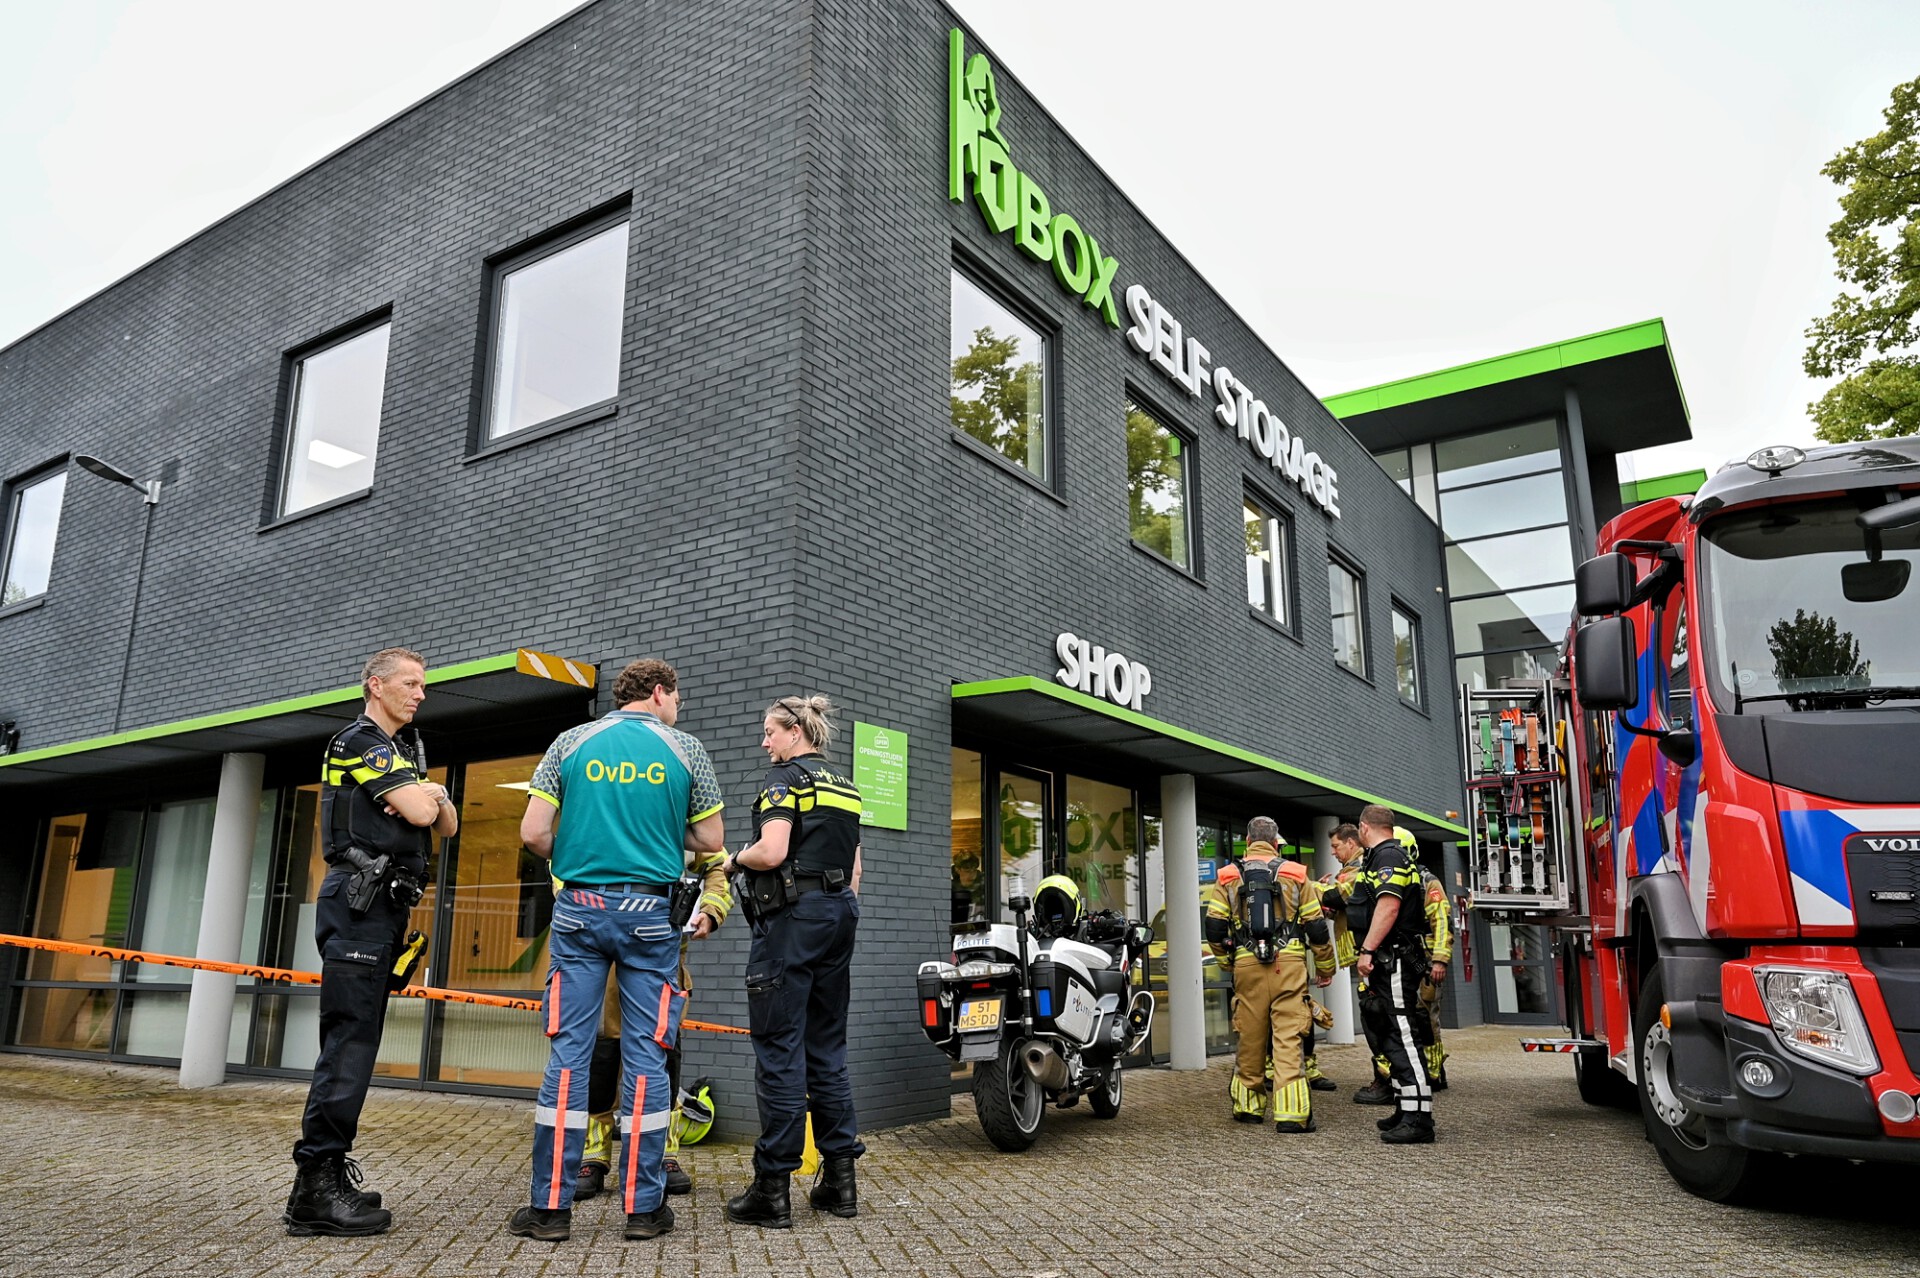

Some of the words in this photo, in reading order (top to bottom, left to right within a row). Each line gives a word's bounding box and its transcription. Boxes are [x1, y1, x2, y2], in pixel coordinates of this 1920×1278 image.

[1126, 284, 1211, 398] SELF
[1213, 365, 1341, 519] STORAGE
[1056, 632, 1151, 711] SHOP
[586, 759, 665, 784] OvD-G
[957, 938, 990, 949] POLITIE
[977, 1002, 990, 1013] 51
